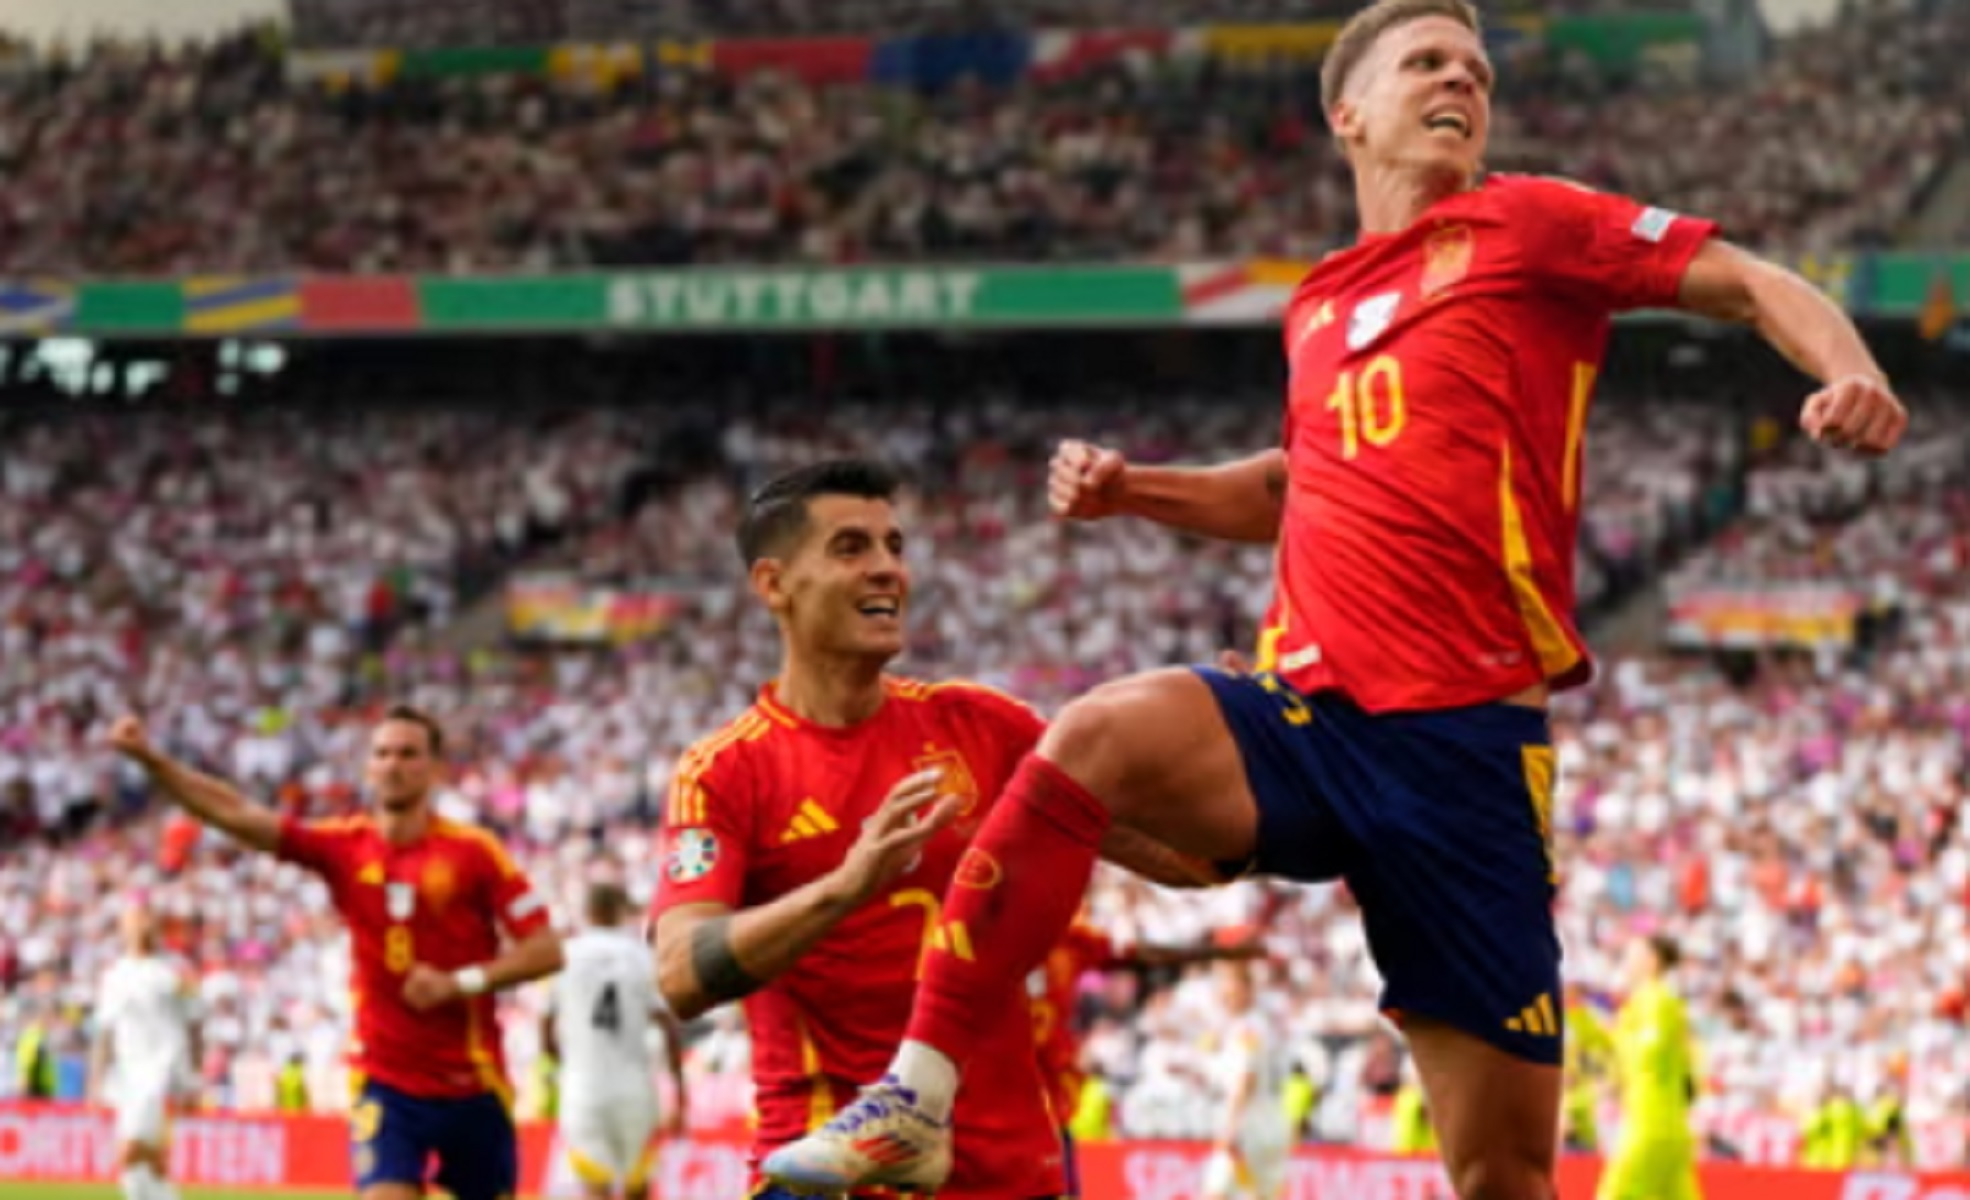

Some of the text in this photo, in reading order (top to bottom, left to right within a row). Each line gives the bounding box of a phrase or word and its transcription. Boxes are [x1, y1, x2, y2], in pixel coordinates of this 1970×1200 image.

[608, 271, 981, 323] STUTTGART
[1326, 355, 1405, 460] 10
[384, 923, 414, 974] 8
[889, 888, 942, 982] 7
[591, 979, 622, 1036] 4
